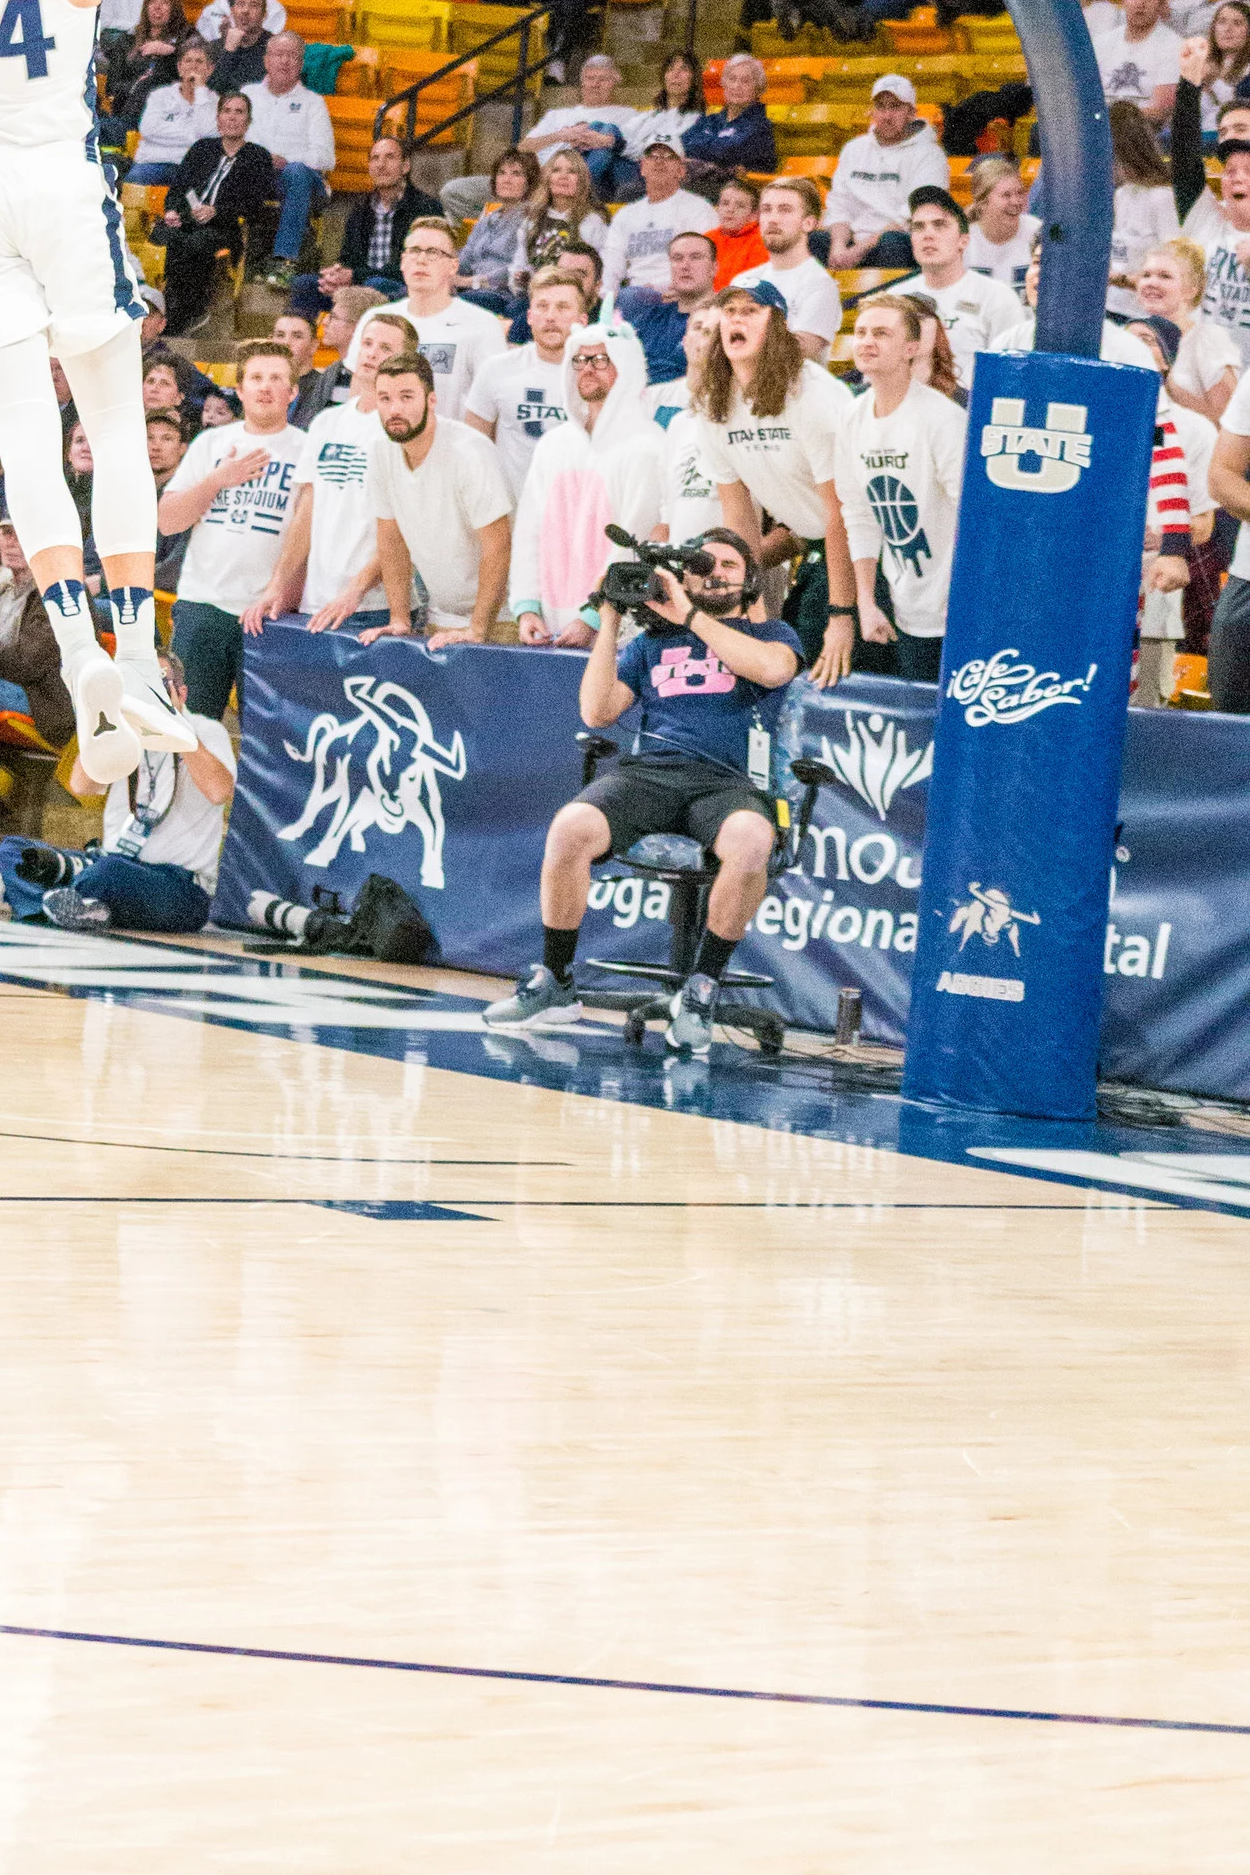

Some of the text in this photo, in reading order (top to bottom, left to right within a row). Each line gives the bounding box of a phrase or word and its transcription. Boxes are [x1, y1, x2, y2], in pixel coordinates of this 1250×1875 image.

[757, 427, 791, 442] STATE
[981, 425, 1093, 468] STATE
[935, 970, 1026, 1003] AGGIES
